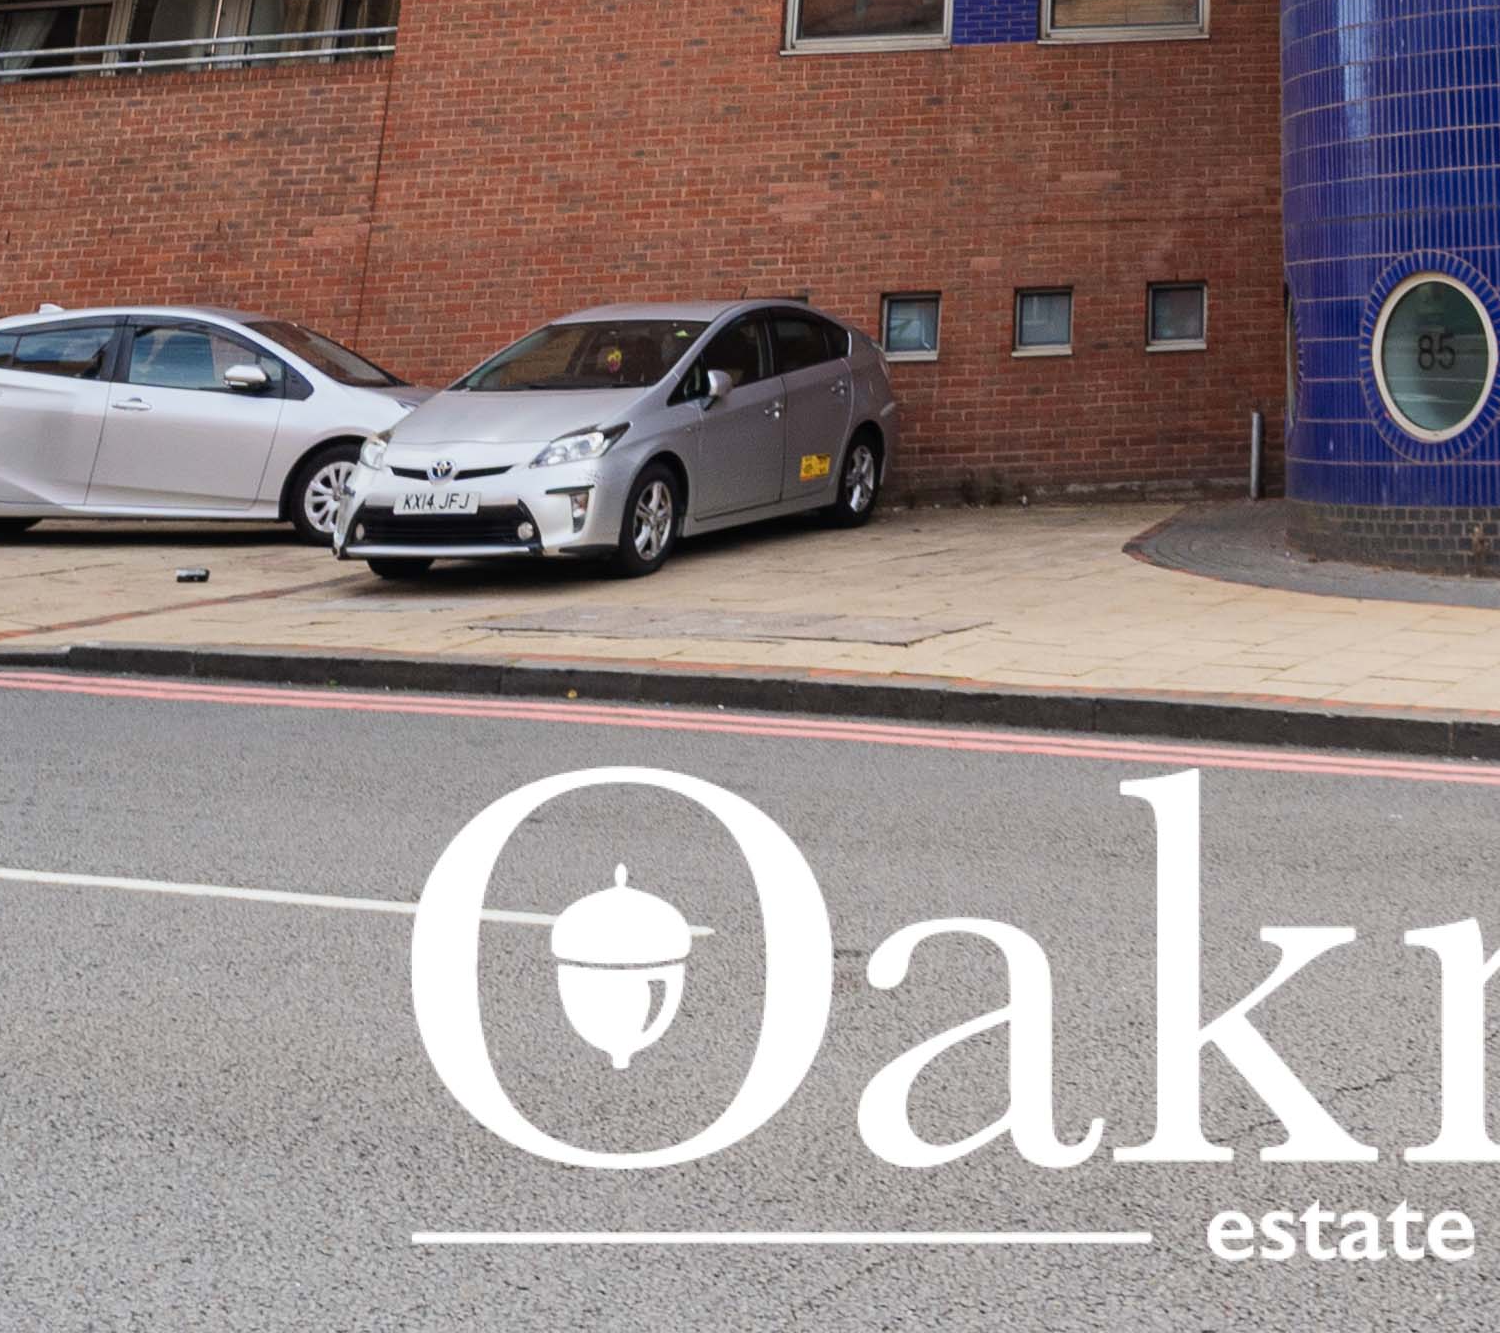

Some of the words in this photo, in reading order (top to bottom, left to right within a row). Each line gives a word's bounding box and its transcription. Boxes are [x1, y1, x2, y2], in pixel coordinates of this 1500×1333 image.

[1418, 333, 1456, 370] 85
[403, 493, 435, 510] KX14
[439, 493, 470, 509] JFJ
